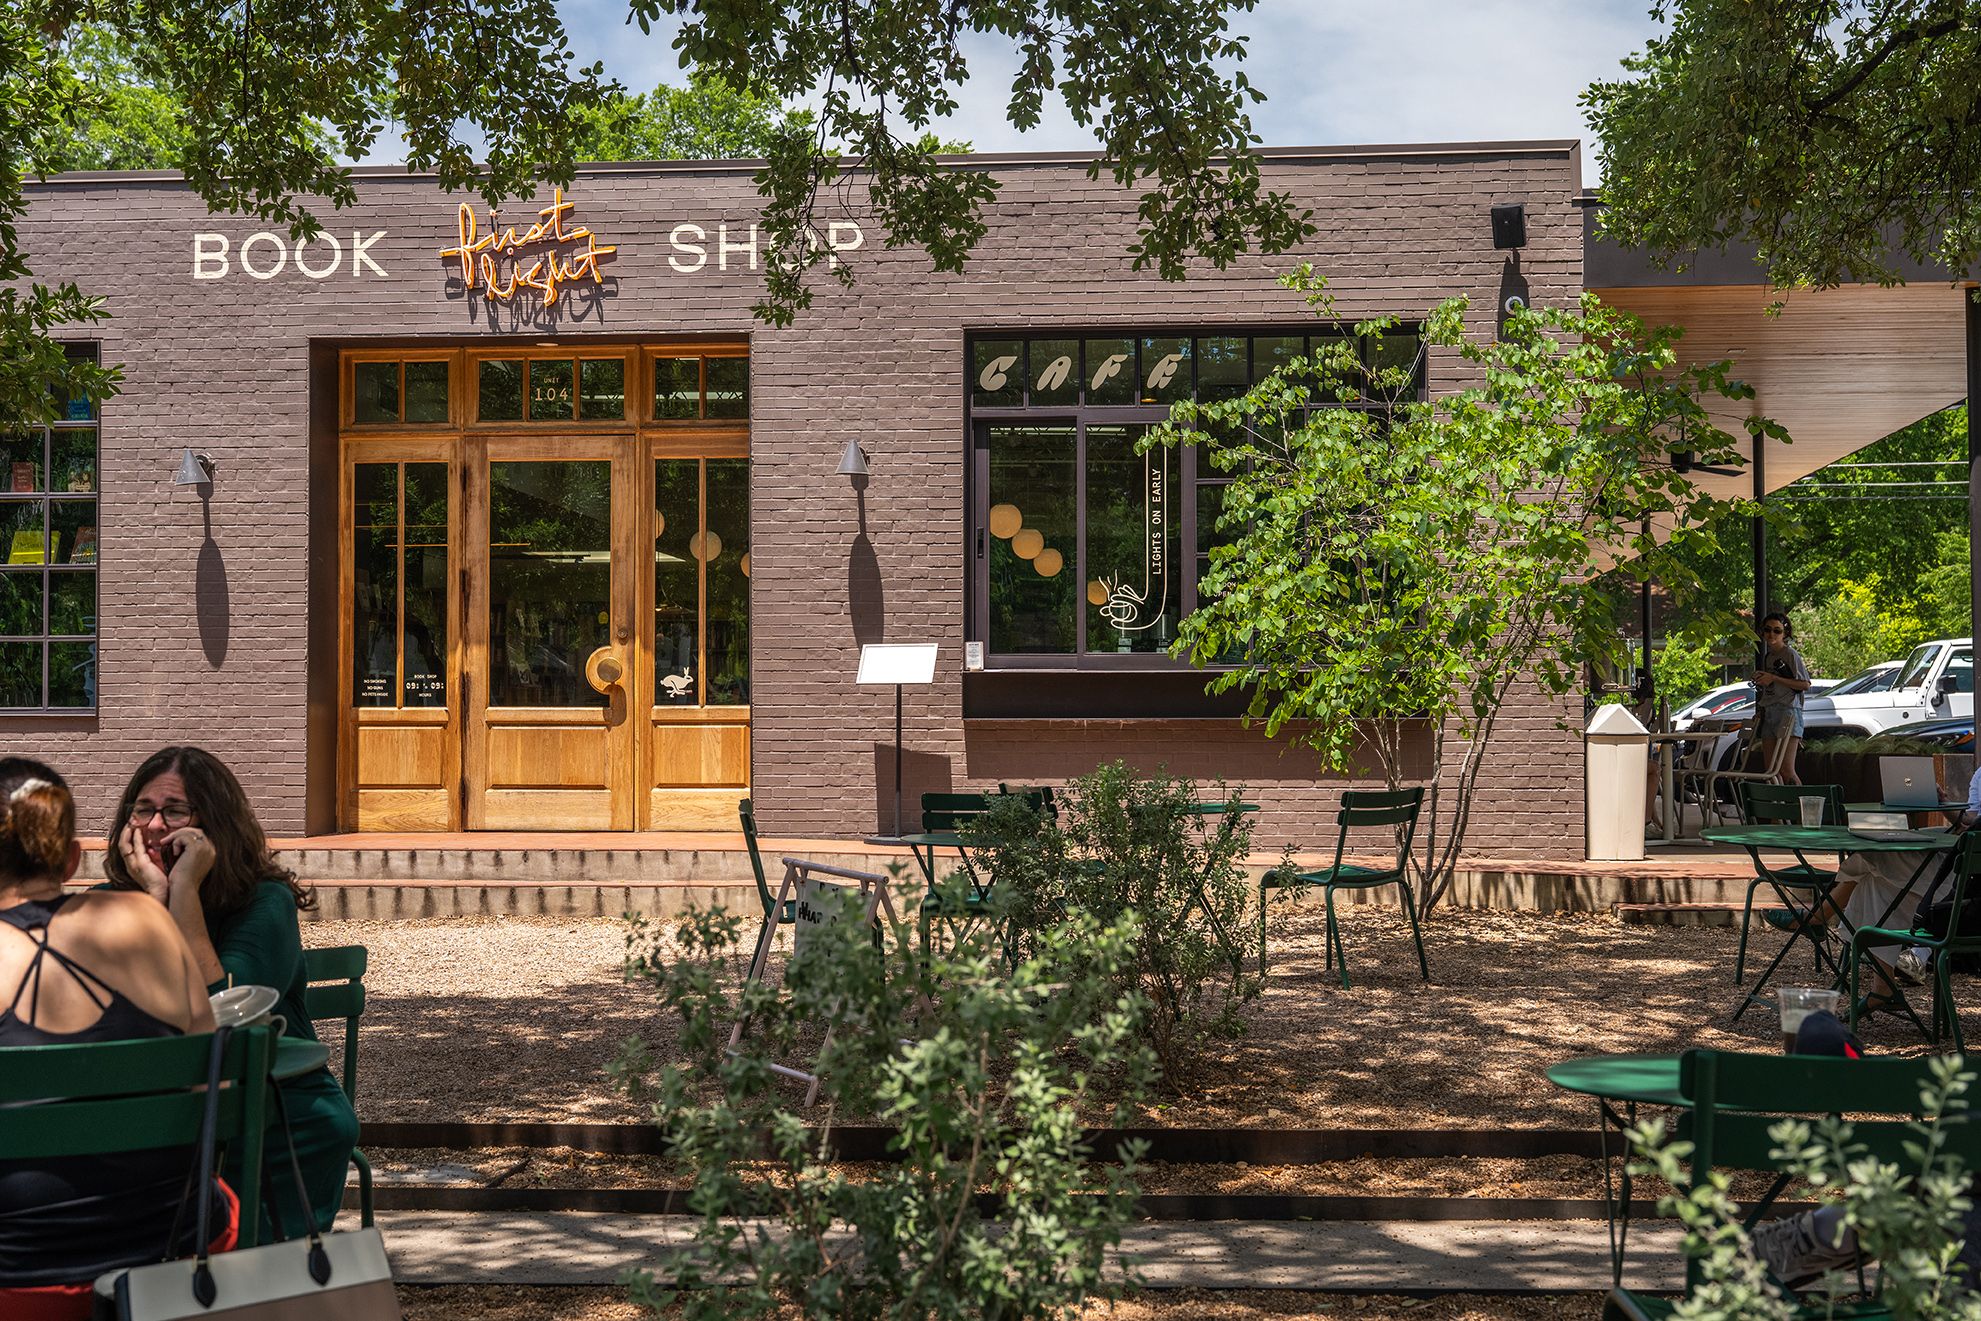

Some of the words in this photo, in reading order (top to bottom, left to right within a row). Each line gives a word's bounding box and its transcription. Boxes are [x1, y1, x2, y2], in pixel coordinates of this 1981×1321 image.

[193, 231, 389, 279] BOOK
[668, 222, 864, 273] SHOP
[439, 188, 590, 289] first
[481, 233, 617, 306] light
[979, 354, 1185, 391] CAFE
[535, 387, 568, 401] 104
[1152, 468, 1162, 502] EARLY
[1152, 510, 1162, 525] ON
[1152, 532, 1162, 575] LIGHTS
